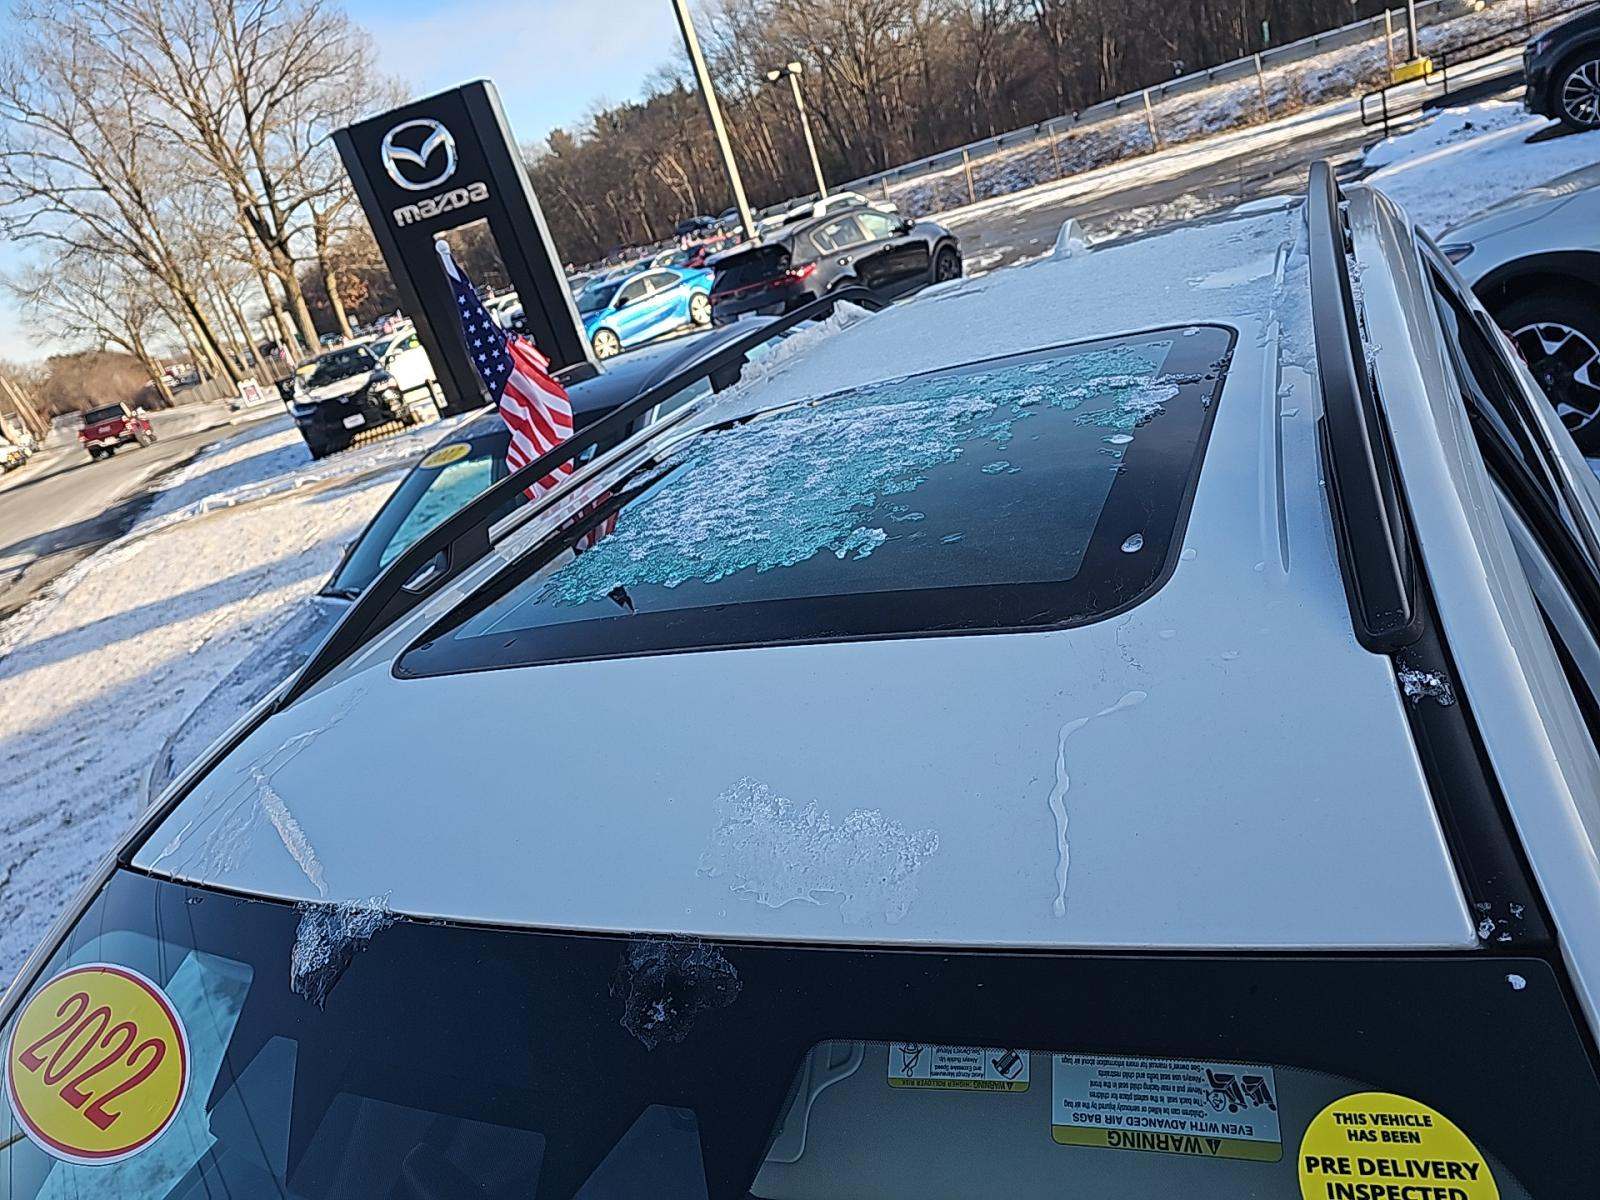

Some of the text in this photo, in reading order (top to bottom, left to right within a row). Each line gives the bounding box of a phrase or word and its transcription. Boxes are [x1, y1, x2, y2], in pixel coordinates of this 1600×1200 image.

[392, 182, 490, 226] mazda
[18, 992, 166, 1131] 2022
[1182, 1074, 1202, 1083] Always
[1186, 1087, 1203, 1095] Never
[1063, 1100, 1073, 1108] bag
[1091, 1101, 1098, 1110] by
[1098, 1102, 1116, 1112] injured
[1193, 1098, 1204, 1106] The
[1117, 1104, 1140, 1113] seriously
[1148, 1106, 1162, 1116] killed
[1170, 1108, 1180, 1116] can
[1181, 1109, 1205, 1118] Children
[1072, 1112, 1254, 1136] EVEN WITH ADVANCED AIR BAGS
[1333, 1113, 1433, 1127] THIS VEHICLE
[1348, 1130, 1421, 1143] HAS BEEN
[1107, 1130, 1202, 1154] WARNING
[1305, 1156, 1480, 1180] PRE DELIVERY
[1327, 1182, 1468, 1200] INSPECTED
